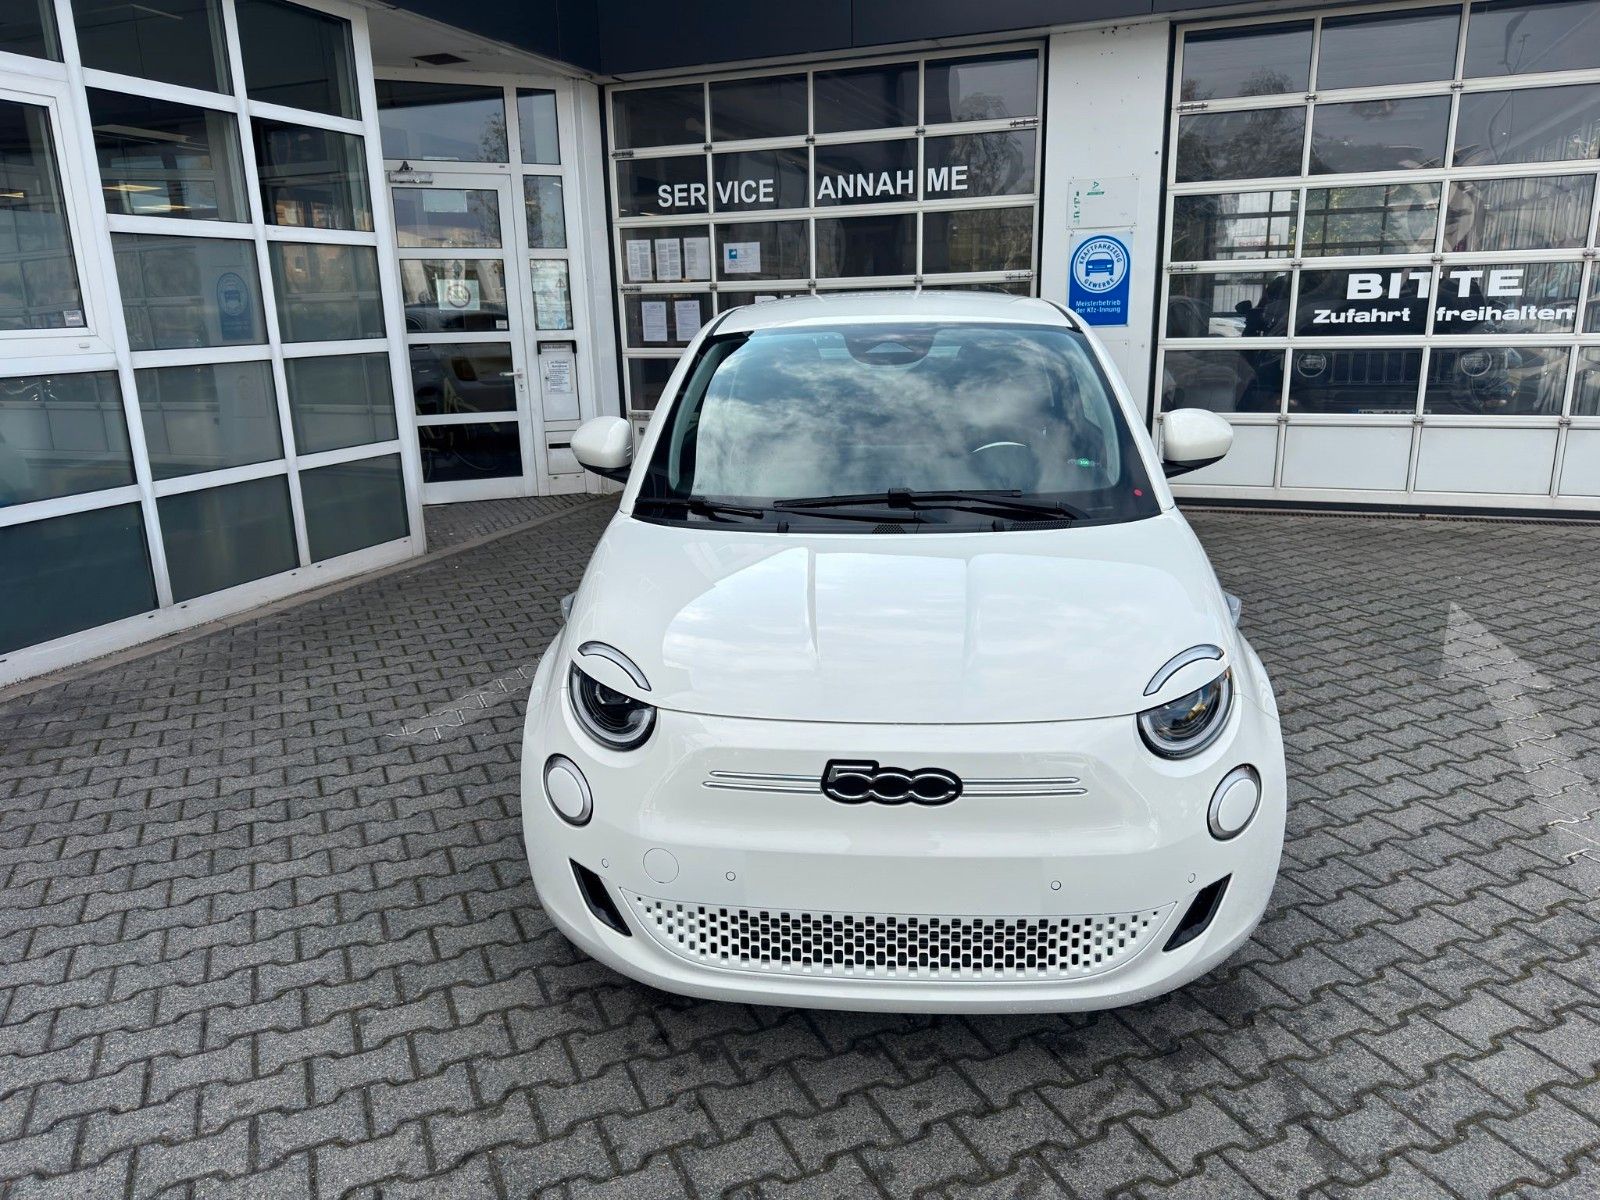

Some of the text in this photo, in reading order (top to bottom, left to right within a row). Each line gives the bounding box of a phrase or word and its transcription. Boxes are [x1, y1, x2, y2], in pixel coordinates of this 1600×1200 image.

[657, 165, 968, 208] SERVICE ANNAHME
[1078, 243, 1123, 265] KRAFTFAHRZEUG
[1084, 277, 1115, 289] GEWERBE
[1346, 268, 1524, 300] BITTE
[1086, 306, 1121, 314] Kfz-Innung
[1312, 305, 1577, 324] Zufahrt freihalten
[820, 758, 964, 806] 500
